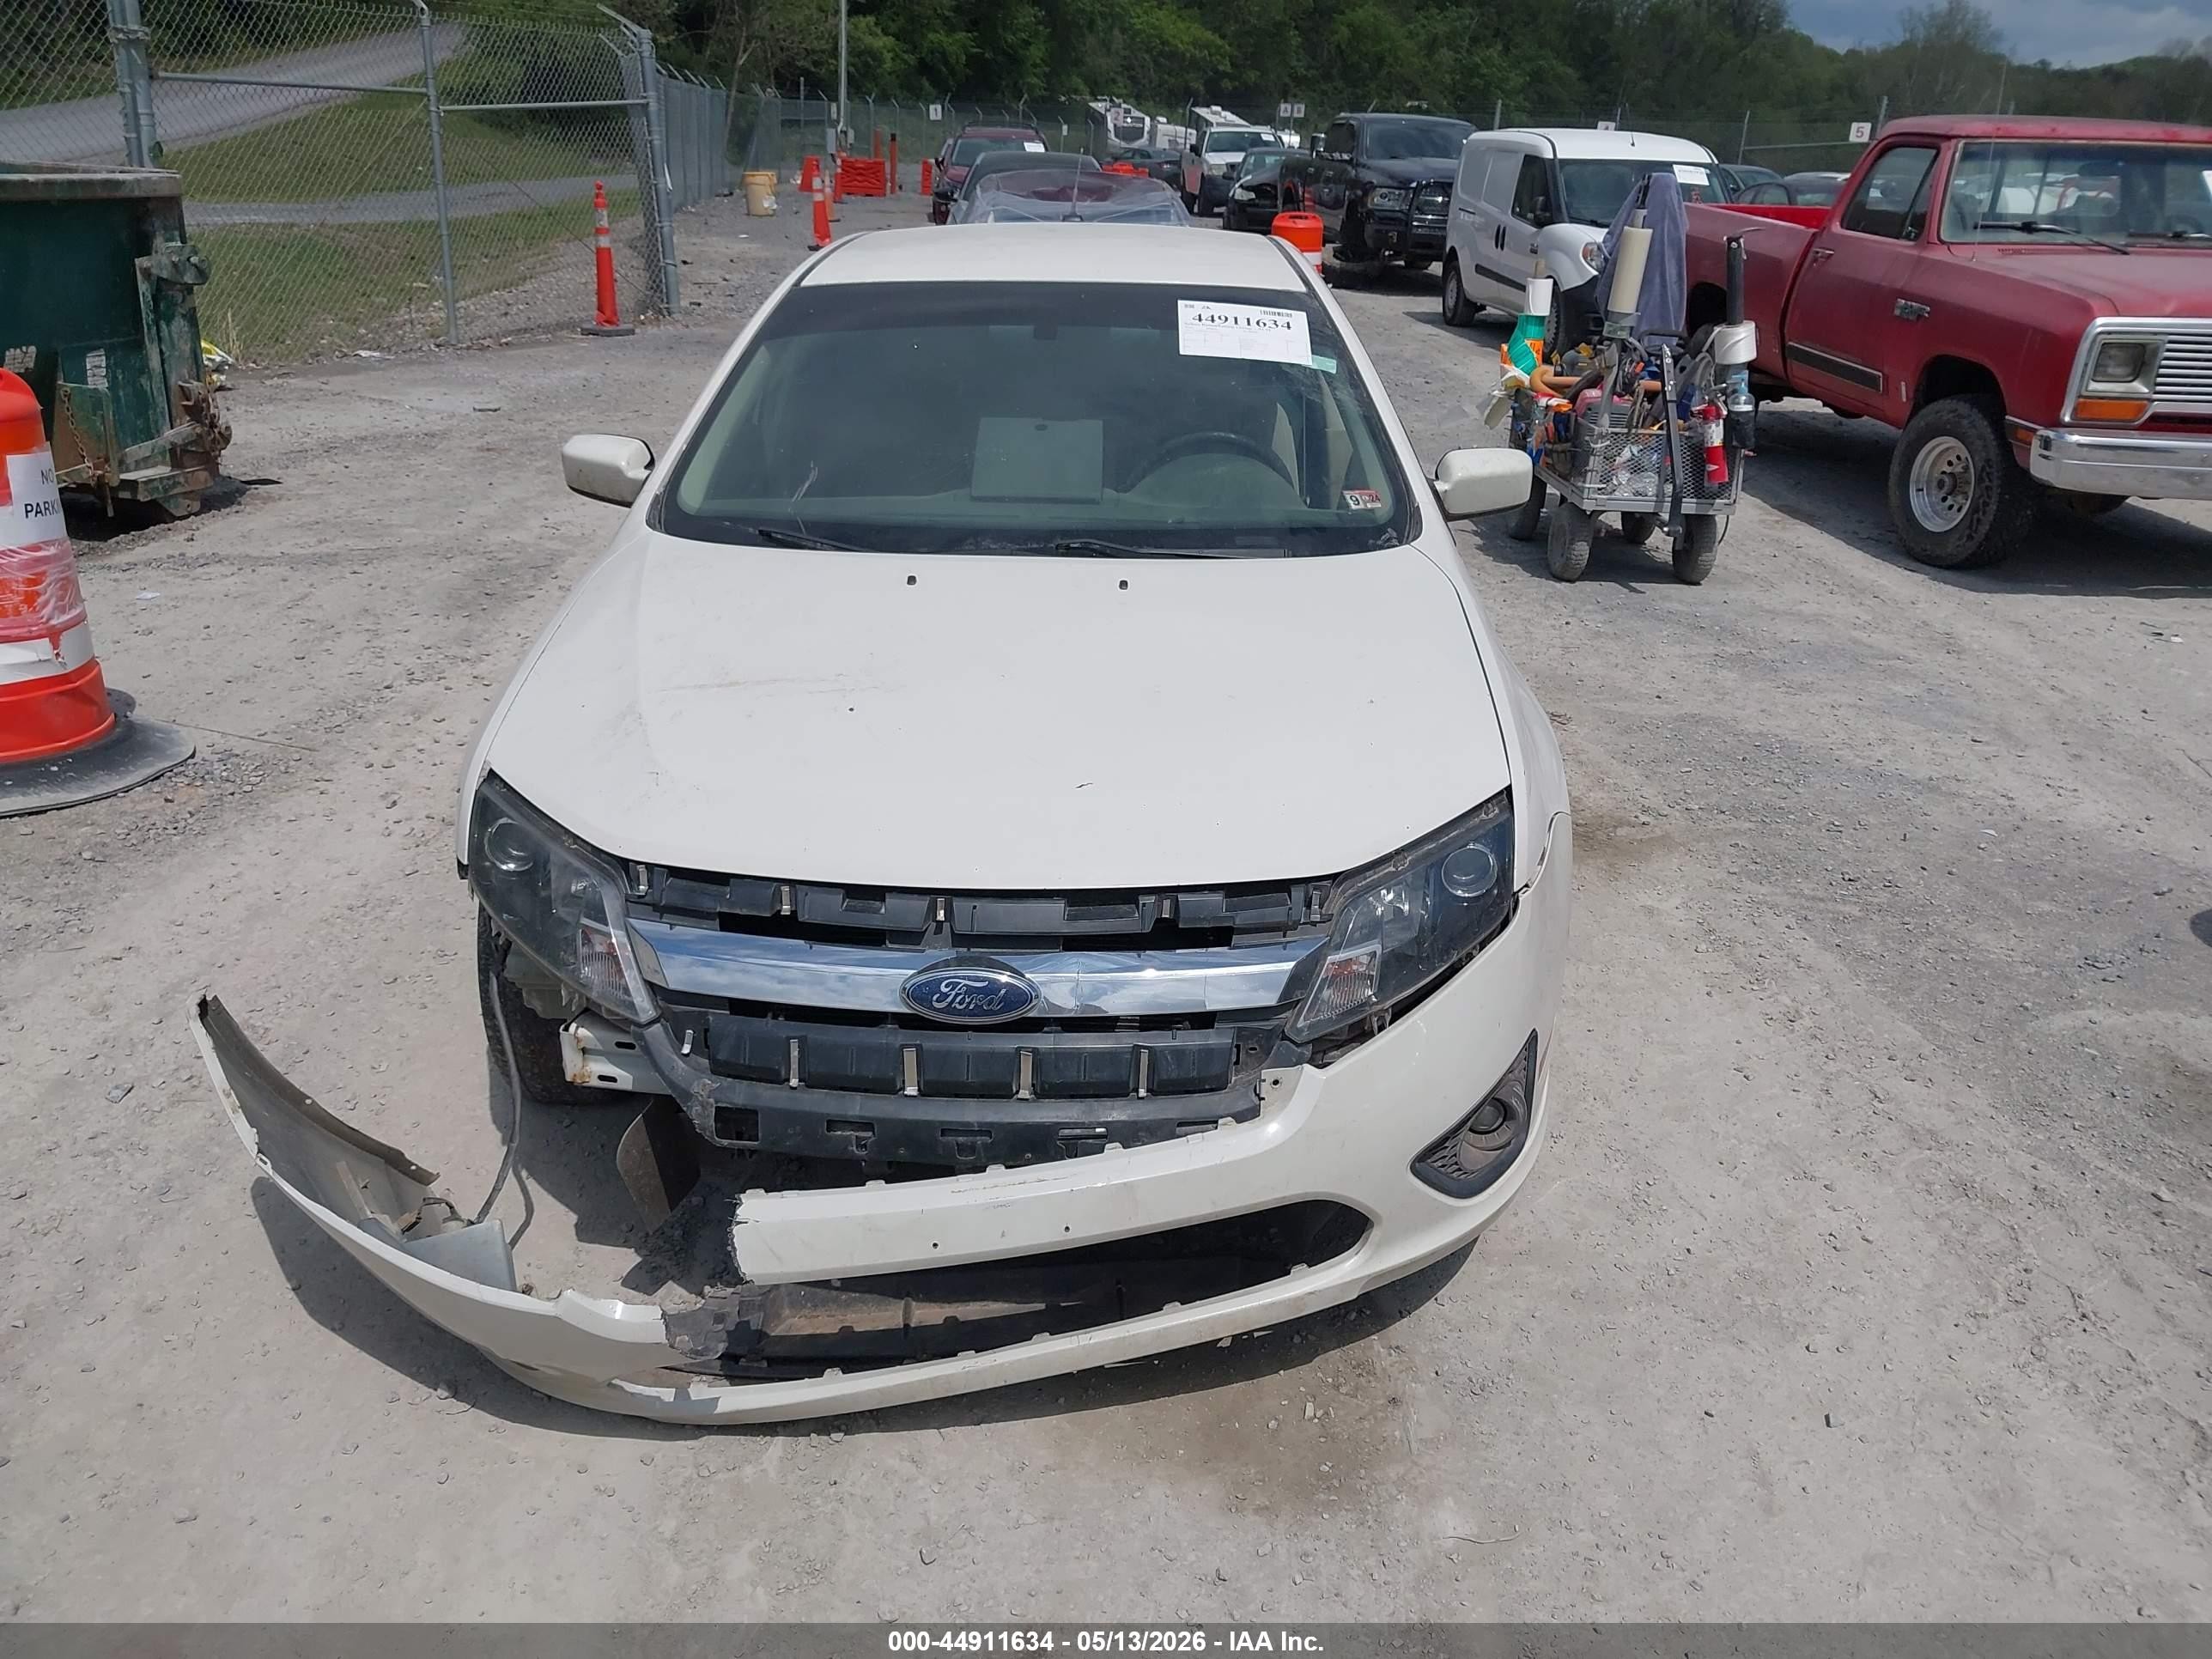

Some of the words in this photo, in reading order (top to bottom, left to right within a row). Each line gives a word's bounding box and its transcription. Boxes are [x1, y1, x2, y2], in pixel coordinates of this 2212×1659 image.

[1856, 126, 1865, 138] 5
[1192, 313, 1292, 331] 44911634
[40, 468, 54, 485] NO
[1350, 495, 1360, 506] 9
[932, 978, 1007, 1010] Ford
